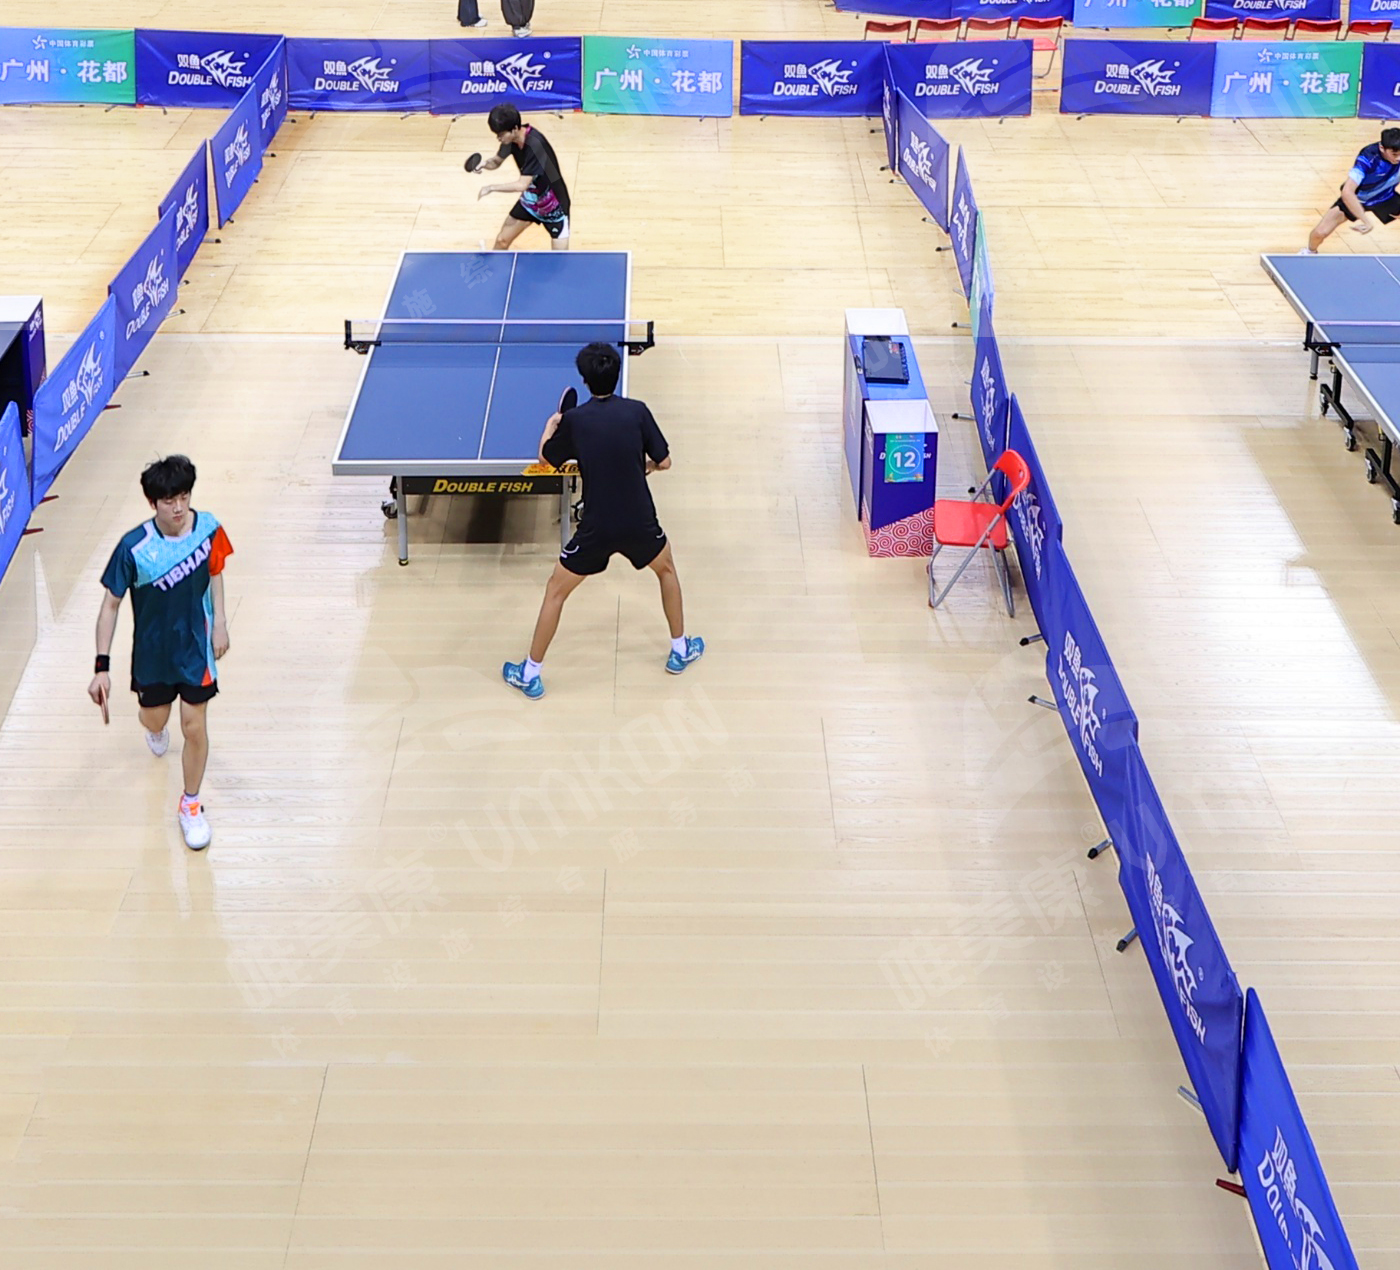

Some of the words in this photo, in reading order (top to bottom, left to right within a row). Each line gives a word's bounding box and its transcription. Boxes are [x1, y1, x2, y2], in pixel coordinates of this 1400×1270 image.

[0, 59, 129, 84] 广州·花都
[527, 79, 555, 91] FISH
[593, 68, 724, 94] 广州·花都
[832, 82, 859, 96] FISH
[1221, 71, 1350, 95] 广州·花都
[894, 450, 917, 468] 12
[432, 478, 496, 495] DOUBLE
[497, 480, 534, 494] FISH
